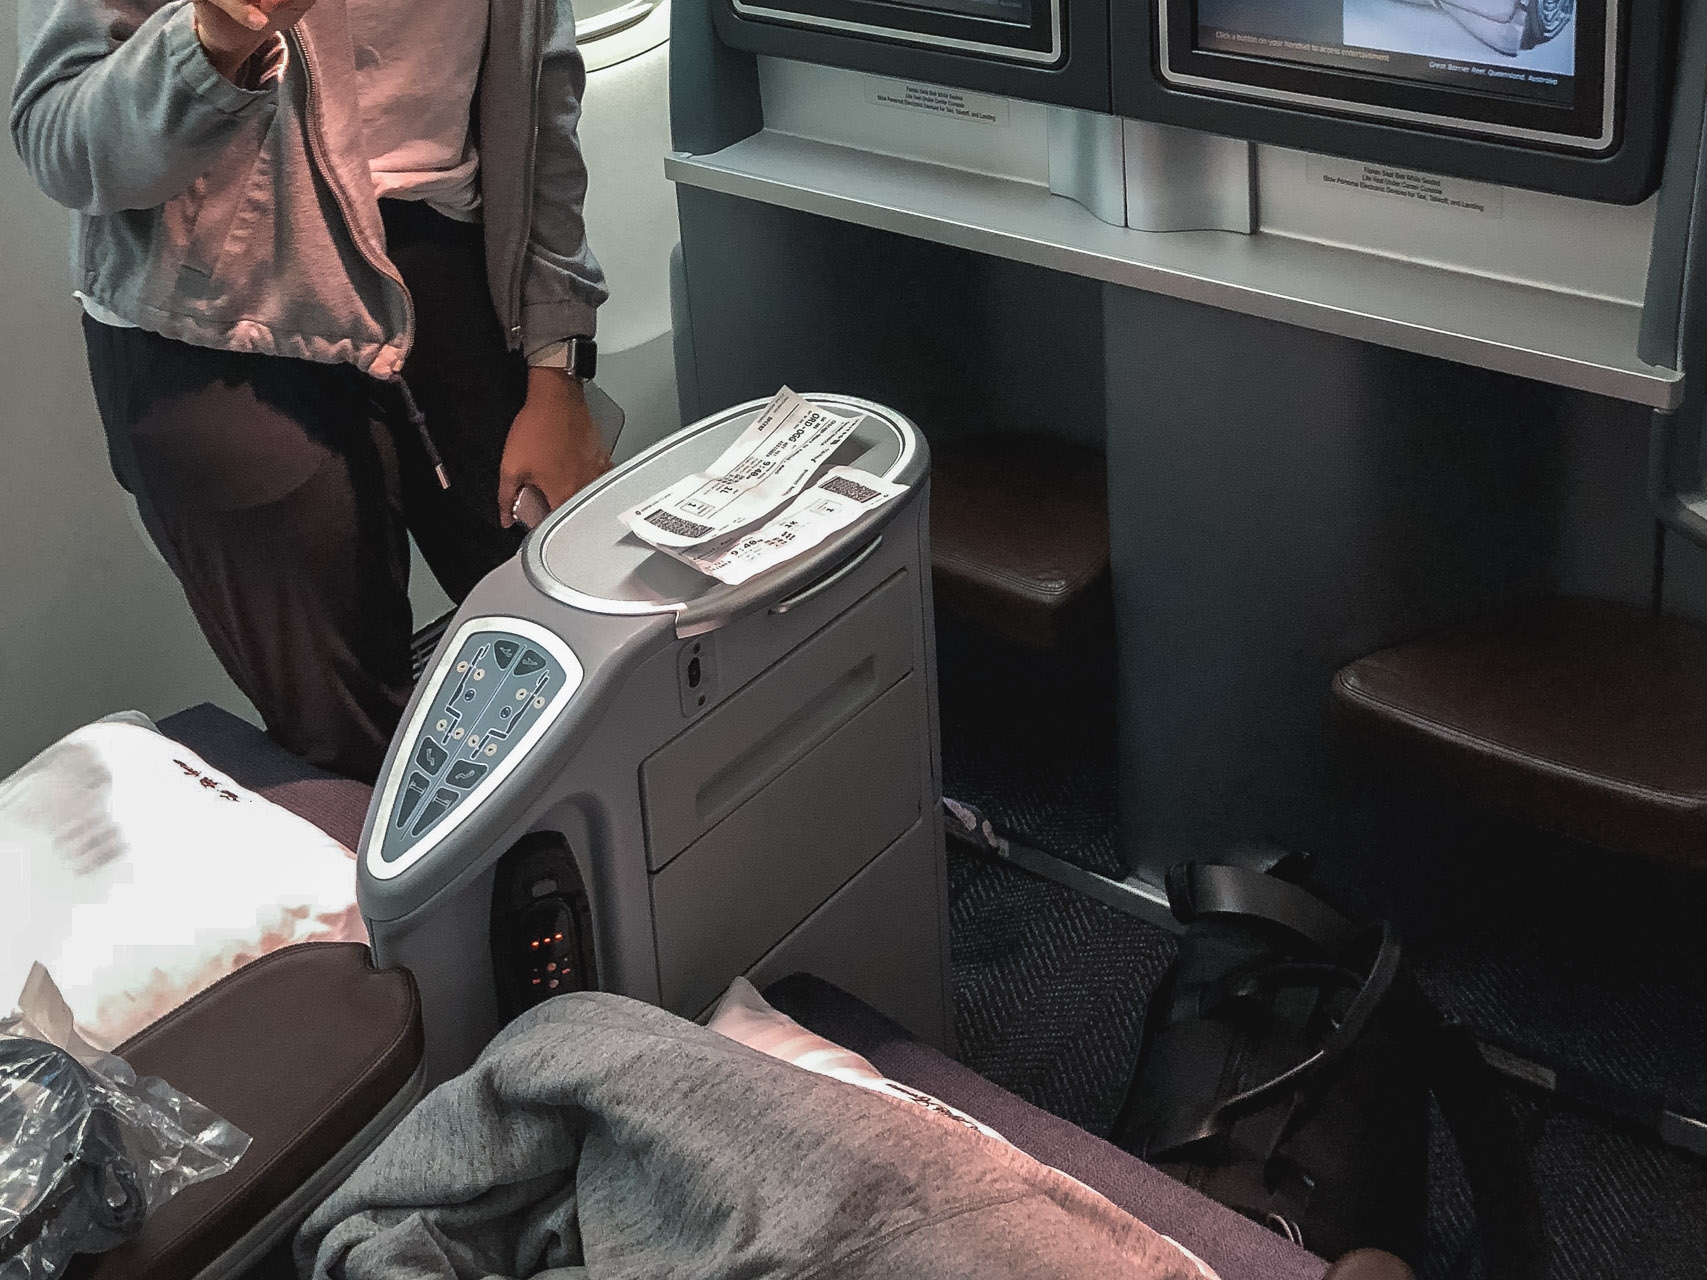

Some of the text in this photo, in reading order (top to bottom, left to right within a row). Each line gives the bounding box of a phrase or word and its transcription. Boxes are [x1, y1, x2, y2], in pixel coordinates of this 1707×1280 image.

[1216, 31, 1230, 40] Click
[1237, 34, 1257, 43] button
[1269, 39, 1283, 47] your
[1284, 40, 1310, 51] handset
[1429, 61, 1446, 70] Great
[788, 412, 820, 442] ORD-OGG
